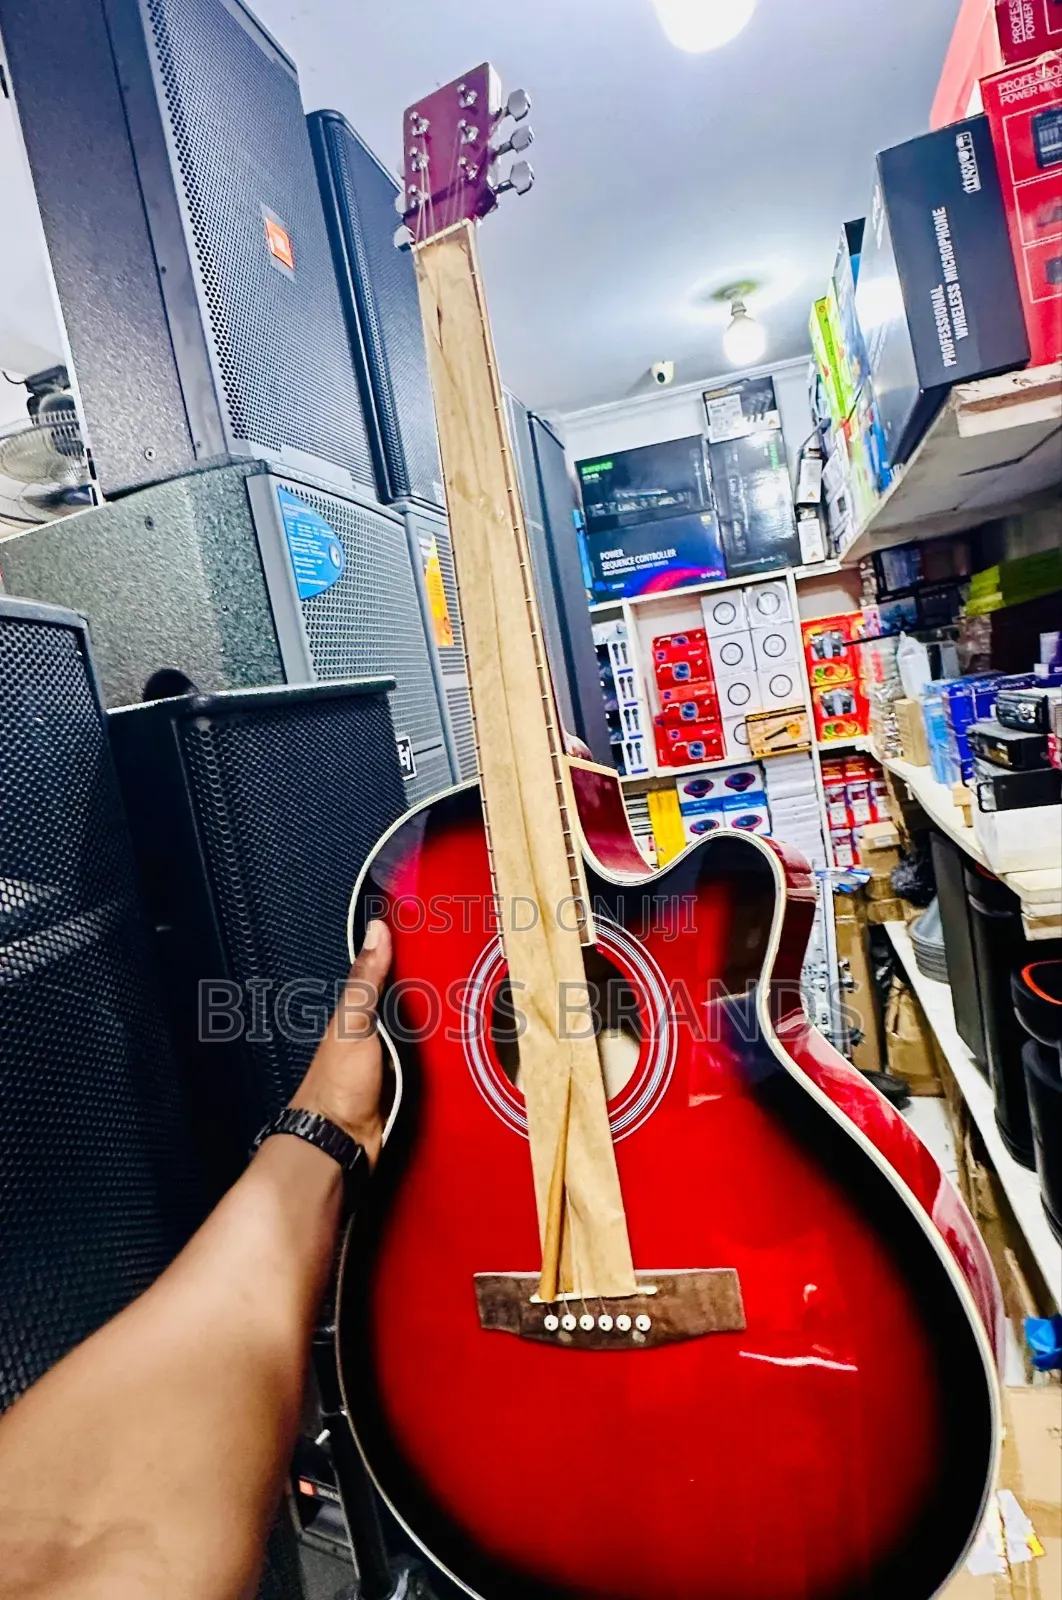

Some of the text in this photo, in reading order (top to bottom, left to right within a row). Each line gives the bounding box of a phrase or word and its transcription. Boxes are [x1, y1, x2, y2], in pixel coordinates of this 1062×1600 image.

[1022, 2, 1036, 40] POWER
[1000, 86, 1038, 106] POWER
[932, 206, 969, 340] WIRELESS MICROPHONE
[930, 284, 957, 367] PROFESSIONAL
[600, 549, 624, 560] POWER
[601, 549, 676, 570] SEQUENCE CONTROLLER
